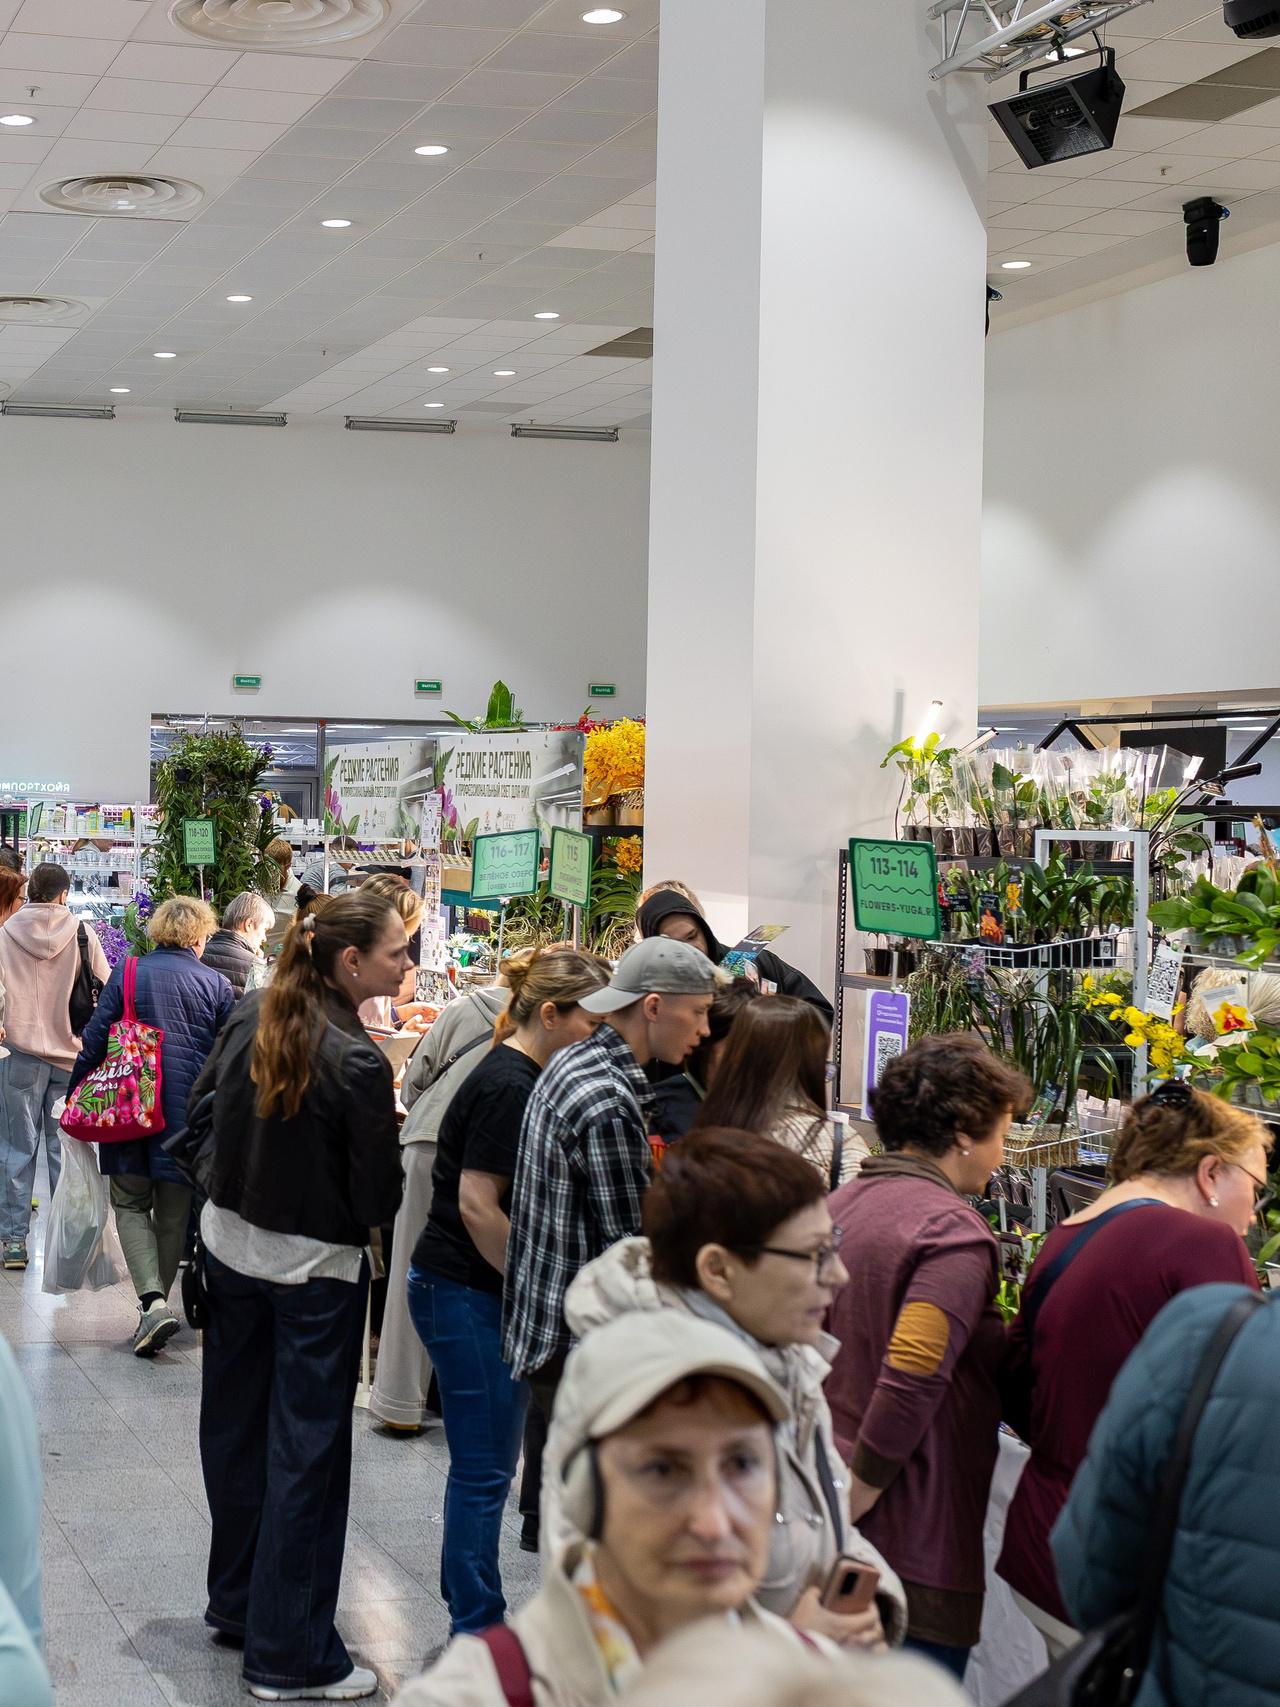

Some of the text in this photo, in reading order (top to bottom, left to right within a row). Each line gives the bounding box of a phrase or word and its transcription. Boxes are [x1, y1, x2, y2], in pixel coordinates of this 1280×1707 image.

[340, 757, 399, 784] РЕДКИЕ РАСТЕНИЯ
[455, 750, 531, 781] РЕДКИЕ РАСТЕНИЯ
[490, 842, 530, 859] 116-117
[567, 844, 579, 861] 115
[479, 871, 509, 881] ЗЕЛЁНОЕ
[871, 857, 919, 878] 113-114
